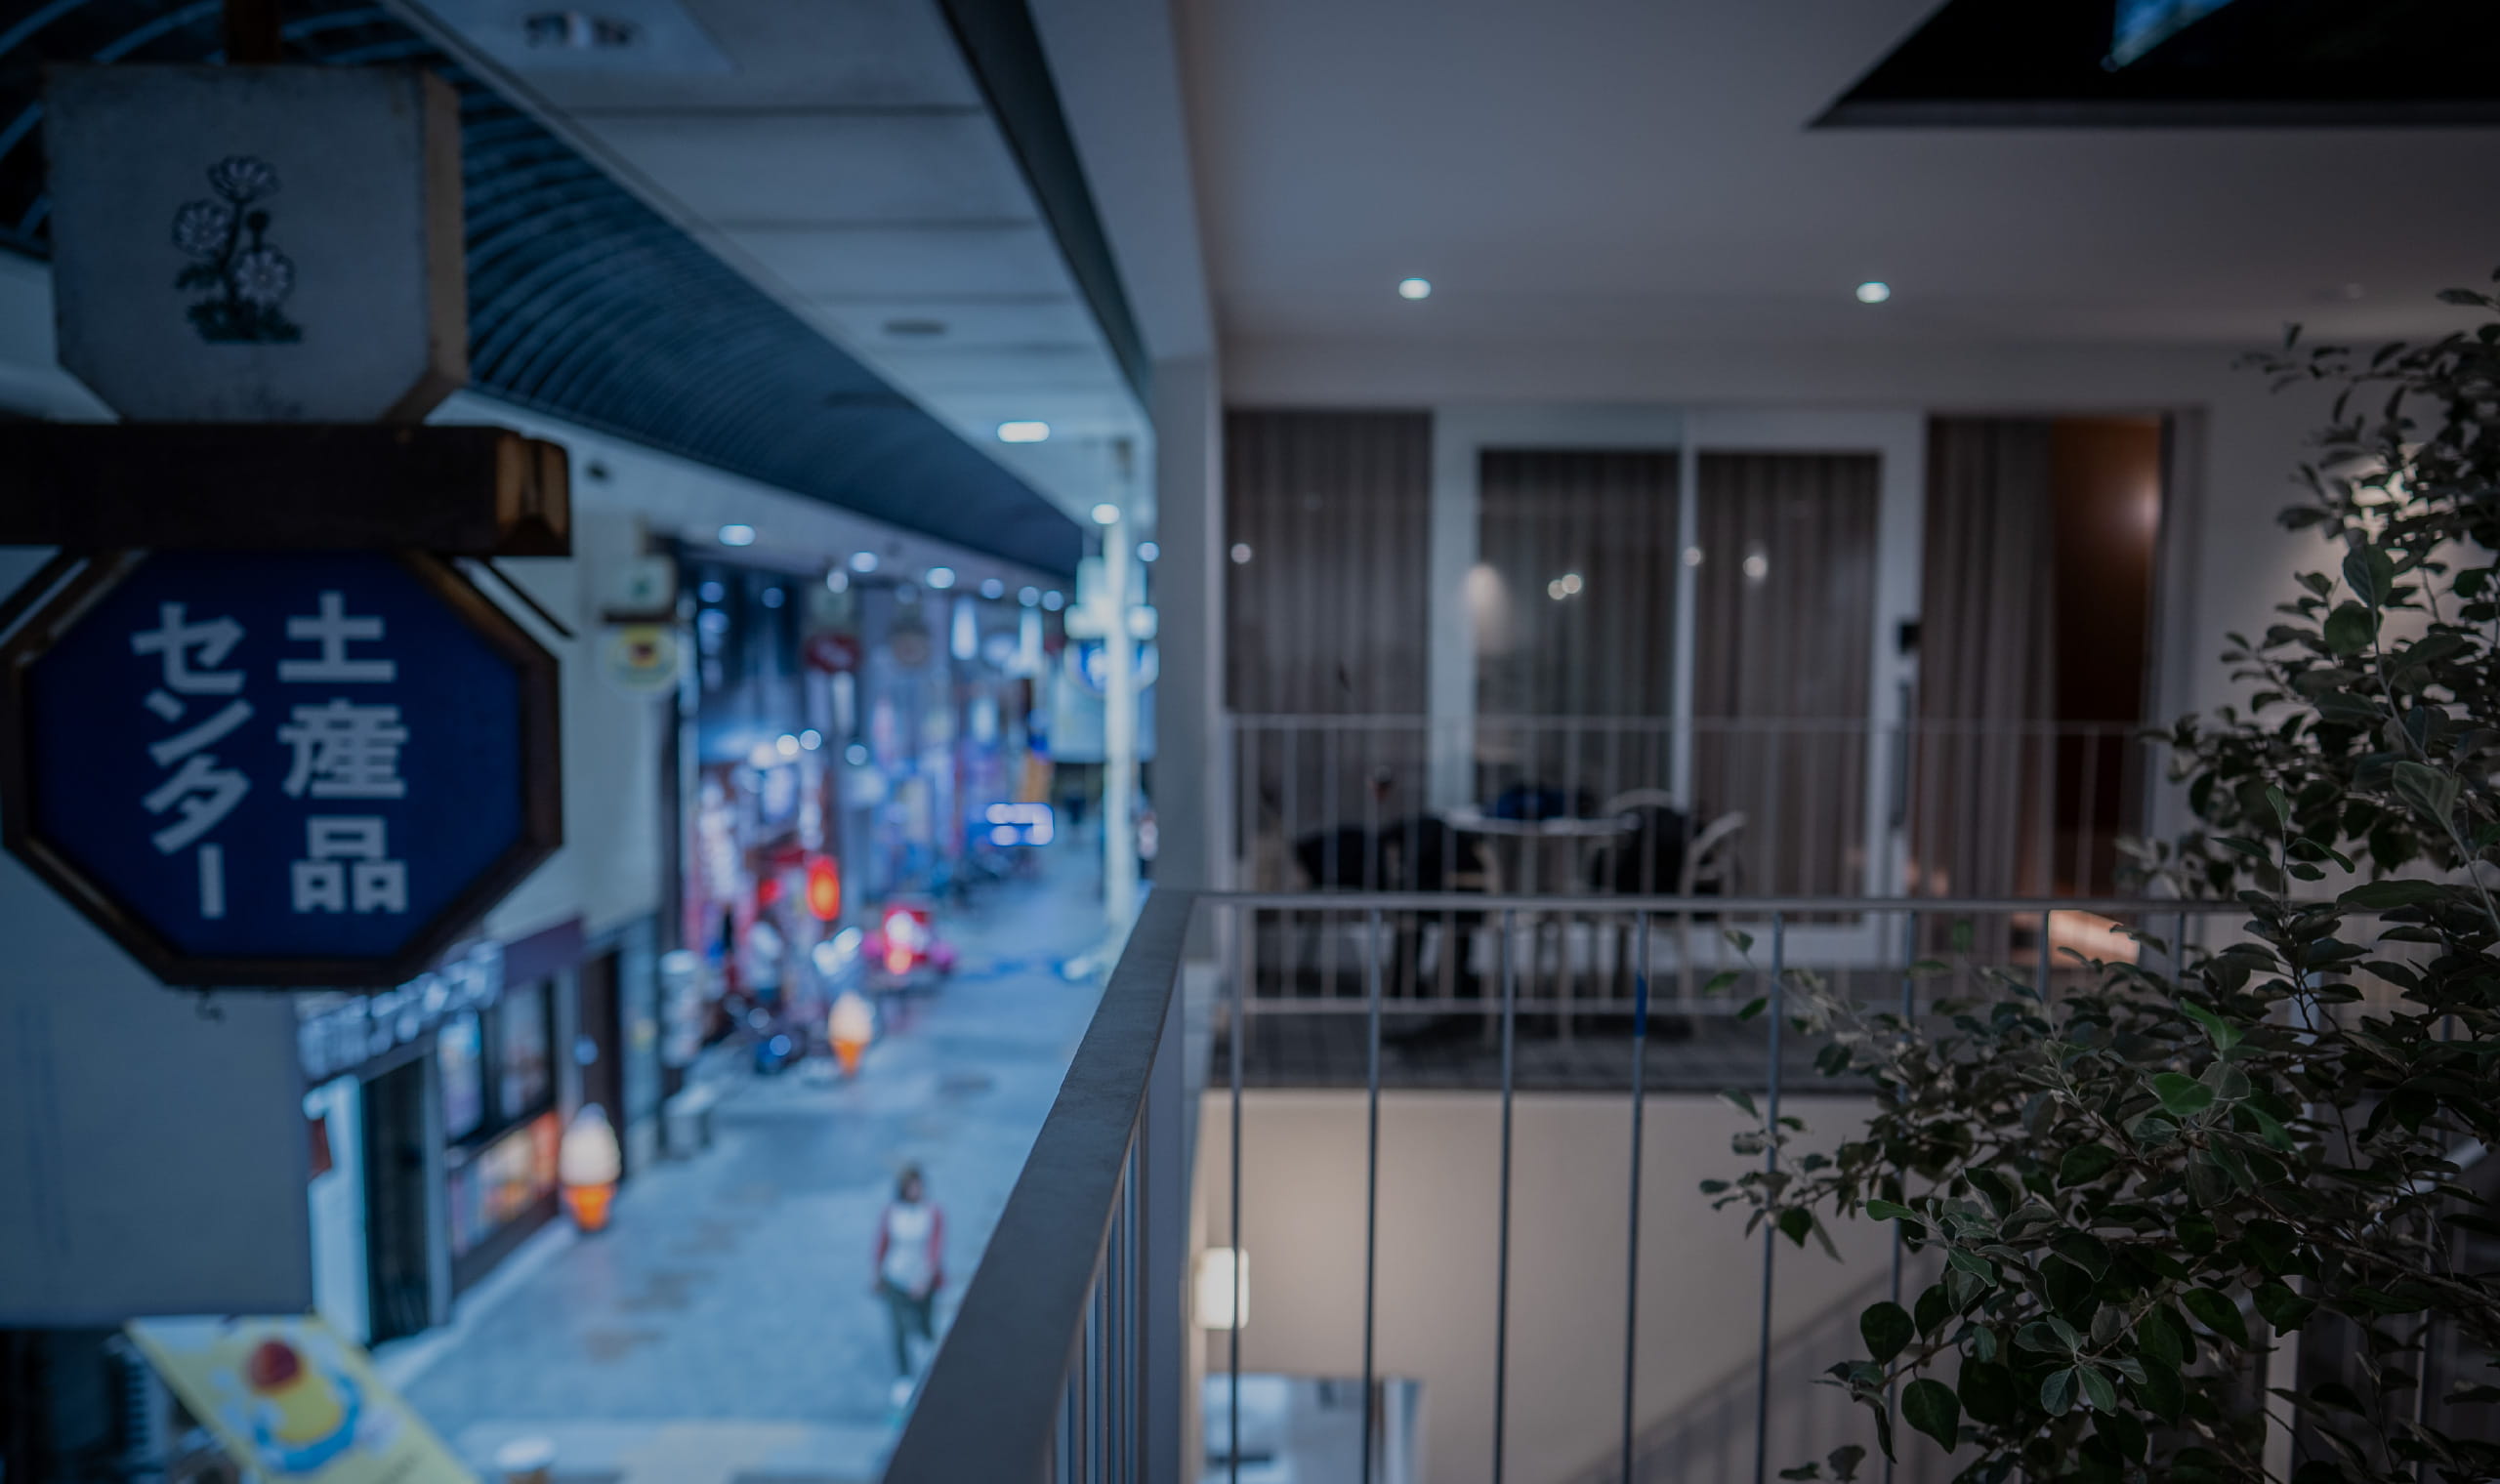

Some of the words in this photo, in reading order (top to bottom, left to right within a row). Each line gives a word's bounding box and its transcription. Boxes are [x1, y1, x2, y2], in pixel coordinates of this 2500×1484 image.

[130, 601, 254, 920] センター
[277, 591, 409, 914] 土産品
